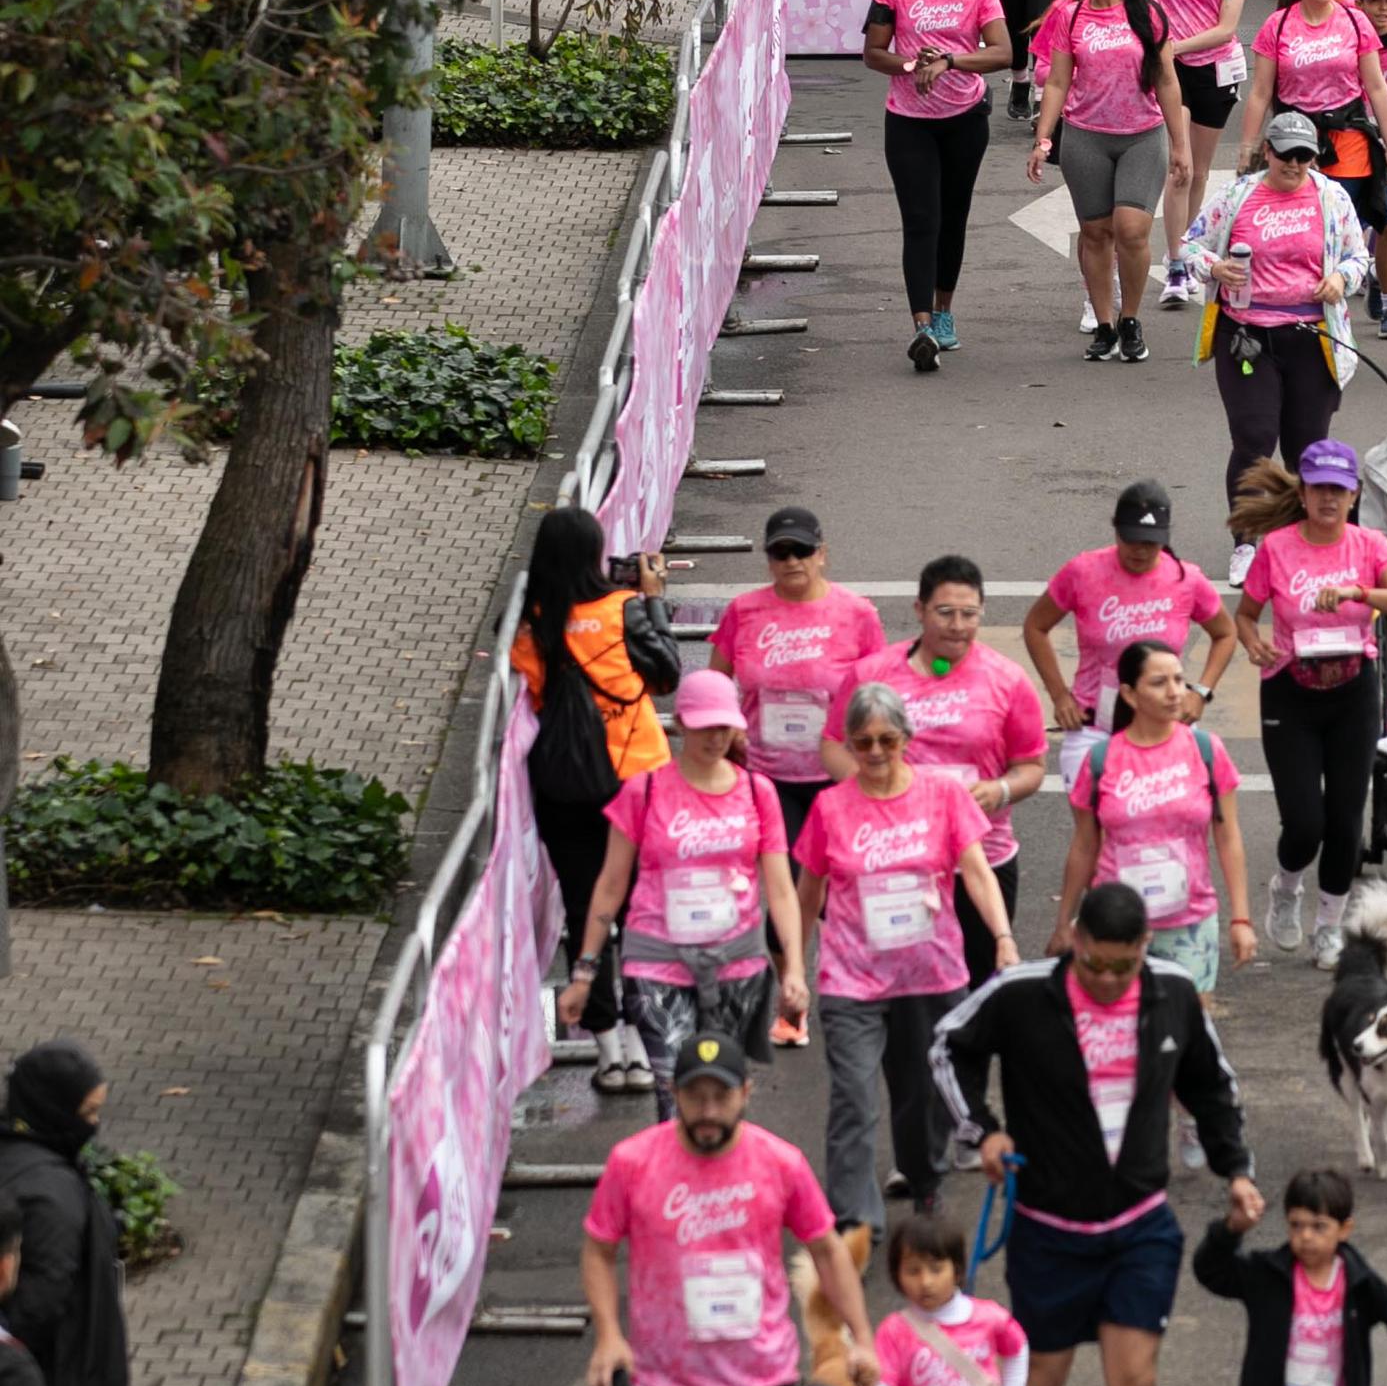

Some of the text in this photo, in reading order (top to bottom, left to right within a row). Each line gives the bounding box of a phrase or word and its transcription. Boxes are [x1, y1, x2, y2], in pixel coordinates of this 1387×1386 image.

[909, 0, 964, 18] Carrera
[915, 16, 959, 34] Rosas
[1089, 35, 1133, 54] Rosas
[1288, 33, 1343, 55] Carrera
[1294, 48, 1340, 69] Rosas
[1252, 205, 1317, 226] Carrera
[1261, 221, 1311, 242] Rosas
[1289, 566, 1360, 596] Carrera
[1098, 596, 1174, 622] Carrera
[757, 622, 832, 650] Carrera
[1106, 618, 1167, 643] Rosas
[765, 643, 824, 669] Rosas
[1115, 762, 1191, 799] Carrera
[1127, 783, 1188, 817] Rosas
[667, 810, 747, 838] Carrera
[852, 817, 929, 853] Carrera
[677, 834, 744, 860] Rosas
[864, 839, 929, 872] Rosas
[662, 1181, 755, 1221] Carrera
